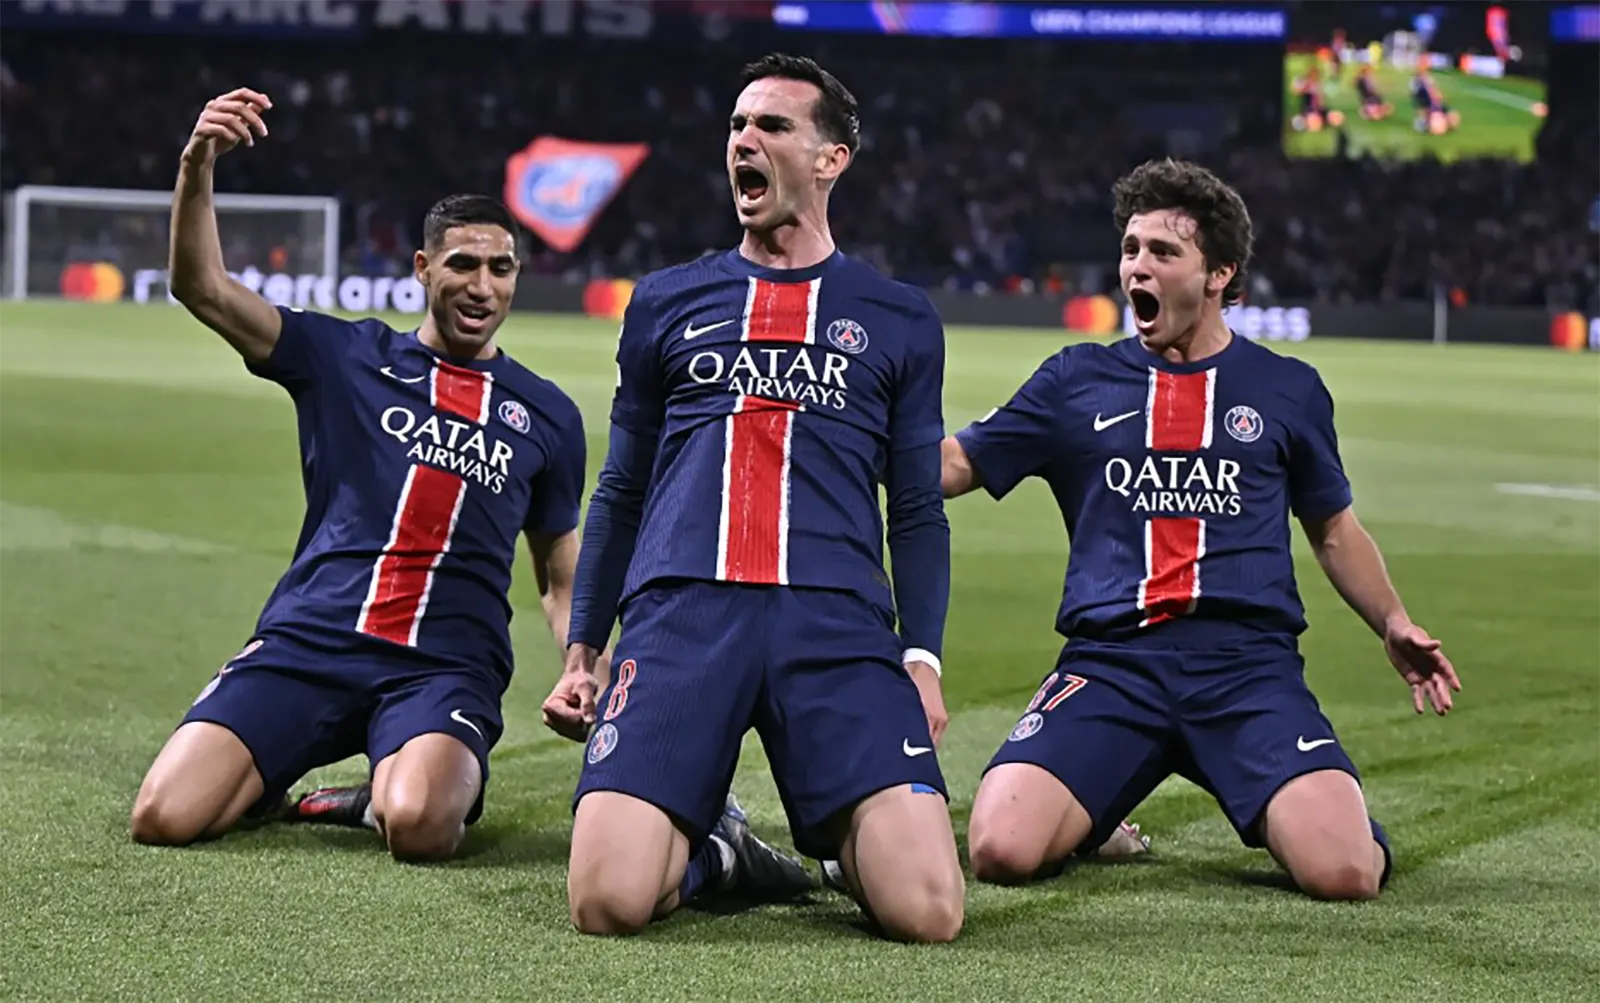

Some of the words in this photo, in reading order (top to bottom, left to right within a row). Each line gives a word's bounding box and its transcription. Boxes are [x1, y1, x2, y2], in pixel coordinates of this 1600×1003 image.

[688, 347, 849, 389] QATAR
[728, 377, 848, 410] AIRWAYS
[380, 406, 513, 476] QATAR
[406, 441, 506, 494] AIRWAYS
[1105, 456, 1241, 498] QATAR
[1132, 491, 1242, 516] AIRWAYS
[604, 659, 637, 721] 8
